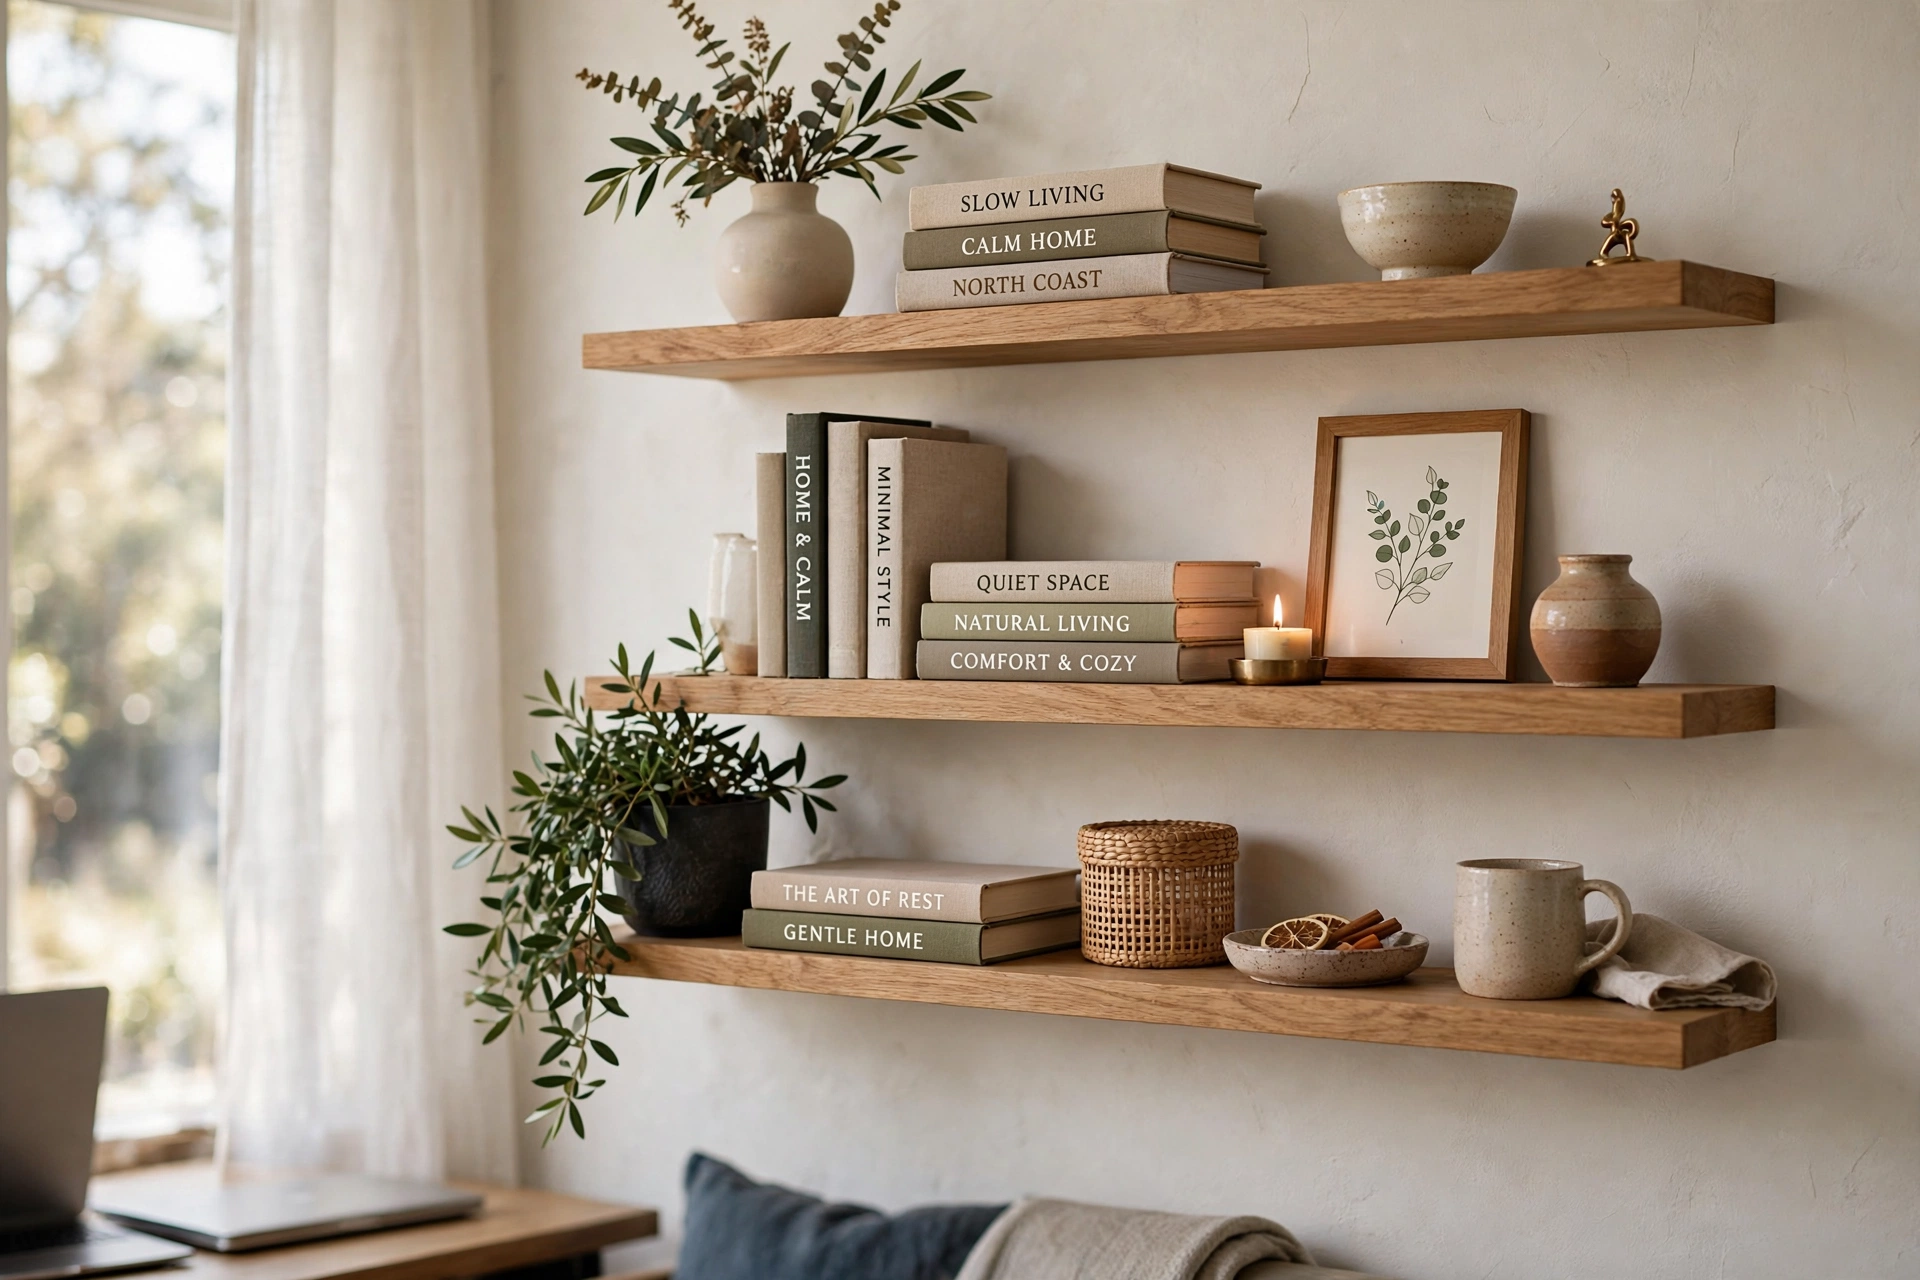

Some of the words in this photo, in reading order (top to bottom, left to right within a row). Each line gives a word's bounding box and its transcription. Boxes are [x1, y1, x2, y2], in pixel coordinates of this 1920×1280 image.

[961, 190, 1021, 213] SLOW
[1029, 183, 1105, 207] LIVING
[961, 233, 1022, 256] CALM
[1029, 228, 1097, 251] HOME
[952, 275, 1025, 297] NORTH
[1033, 269, 1103, 291] COAST
[795, 454, 811, 523] HOME
[877, 466, 891, 557] MINIMAL
[795, 533, 811, 547] &
[795, 556, 811, 621] CALM
[877, 566, 891, 627] STYLE
[976, 574, 1040, 594] QUIET
[1046, 574, 1110, 591] SPACE
[954, 614, 1051, 632] NATURAL
[1057, 614, 1131, 632] LIVING
[950, 652, 1051, 671] COMFORT
[1058, 653, 1072, 671] &
[1080, 654, 1137, 672] COZY
[783, 884, 818, 903] THE
[823, 886, 860, 906] ART
[866, 889, 891, 907] OF
[898, 891, 945, 911] REST
[783, 923, 857, 945] GENTLE
[865, 929, 924, 950] HOME
